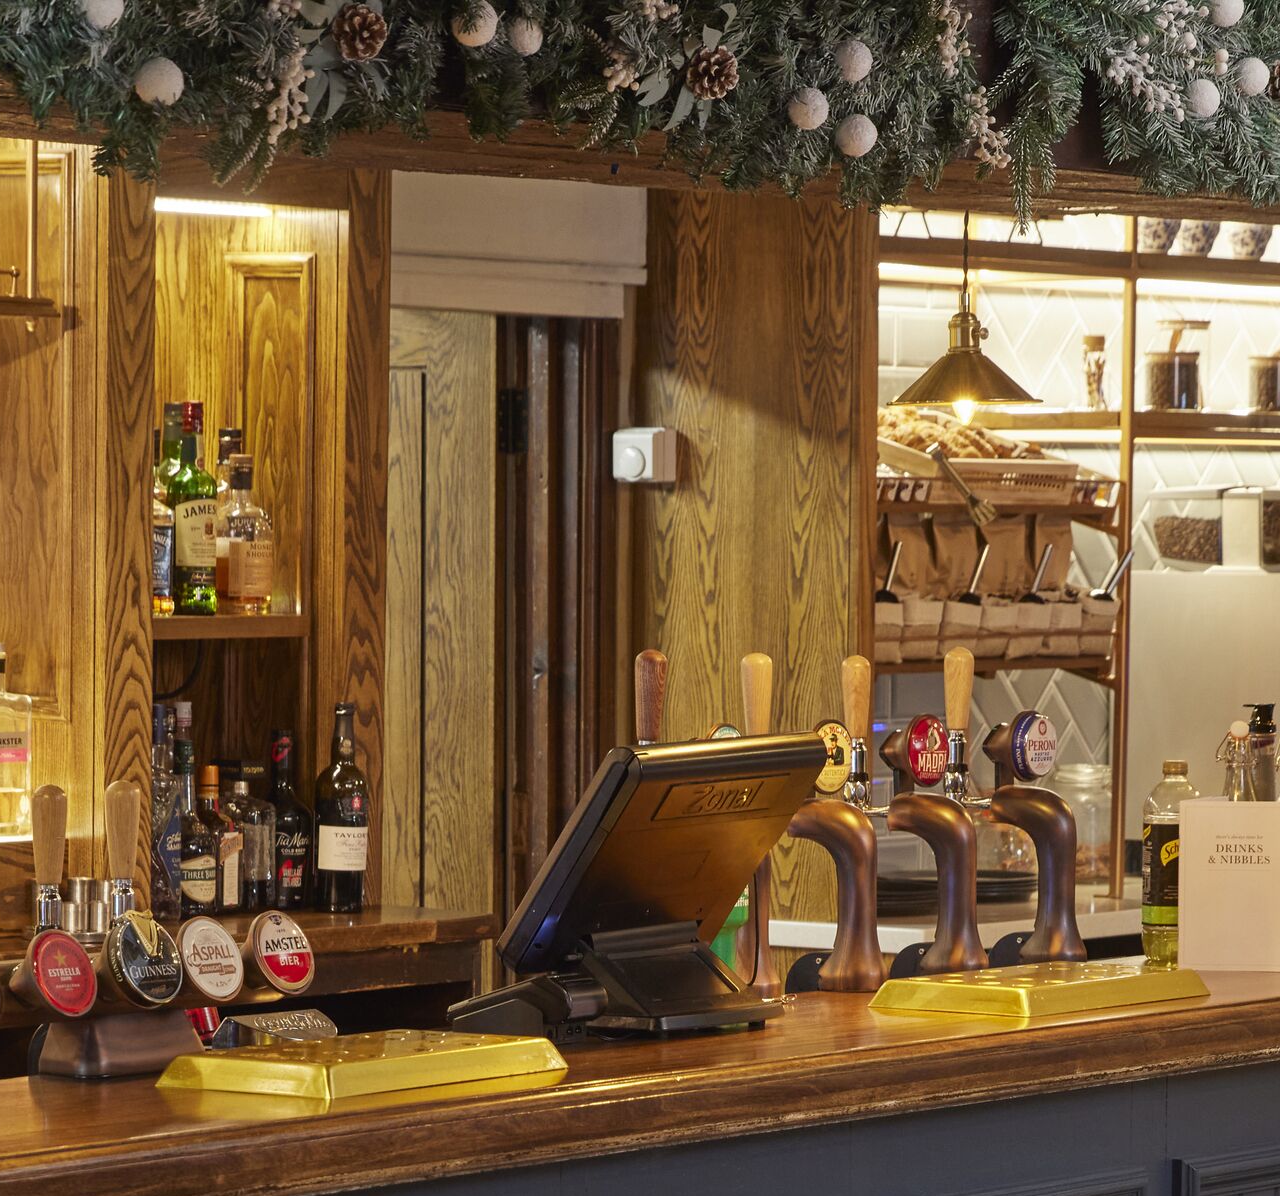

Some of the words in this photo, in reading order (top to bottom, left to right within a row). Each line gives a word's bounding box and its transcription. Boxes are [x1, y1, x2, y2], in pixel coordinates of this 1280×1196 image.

[1028, 739, 1056, 751] PERONI
[1216, 843, 1264, 853] DRINKS
[1208, 856, 1216, 864] &
[1220, 855, 1271, 865] NIBBLES
[182, 869, 206, 880] THREE
[265, 936, 307, 953] AMSTEL
[188, 943, 234, 968] ASPALL
[279, 955, 300, 967] BIER
[48, 967, 81, 978] ESTRELLA
[129, 963, 177, 980] GUINNESS
